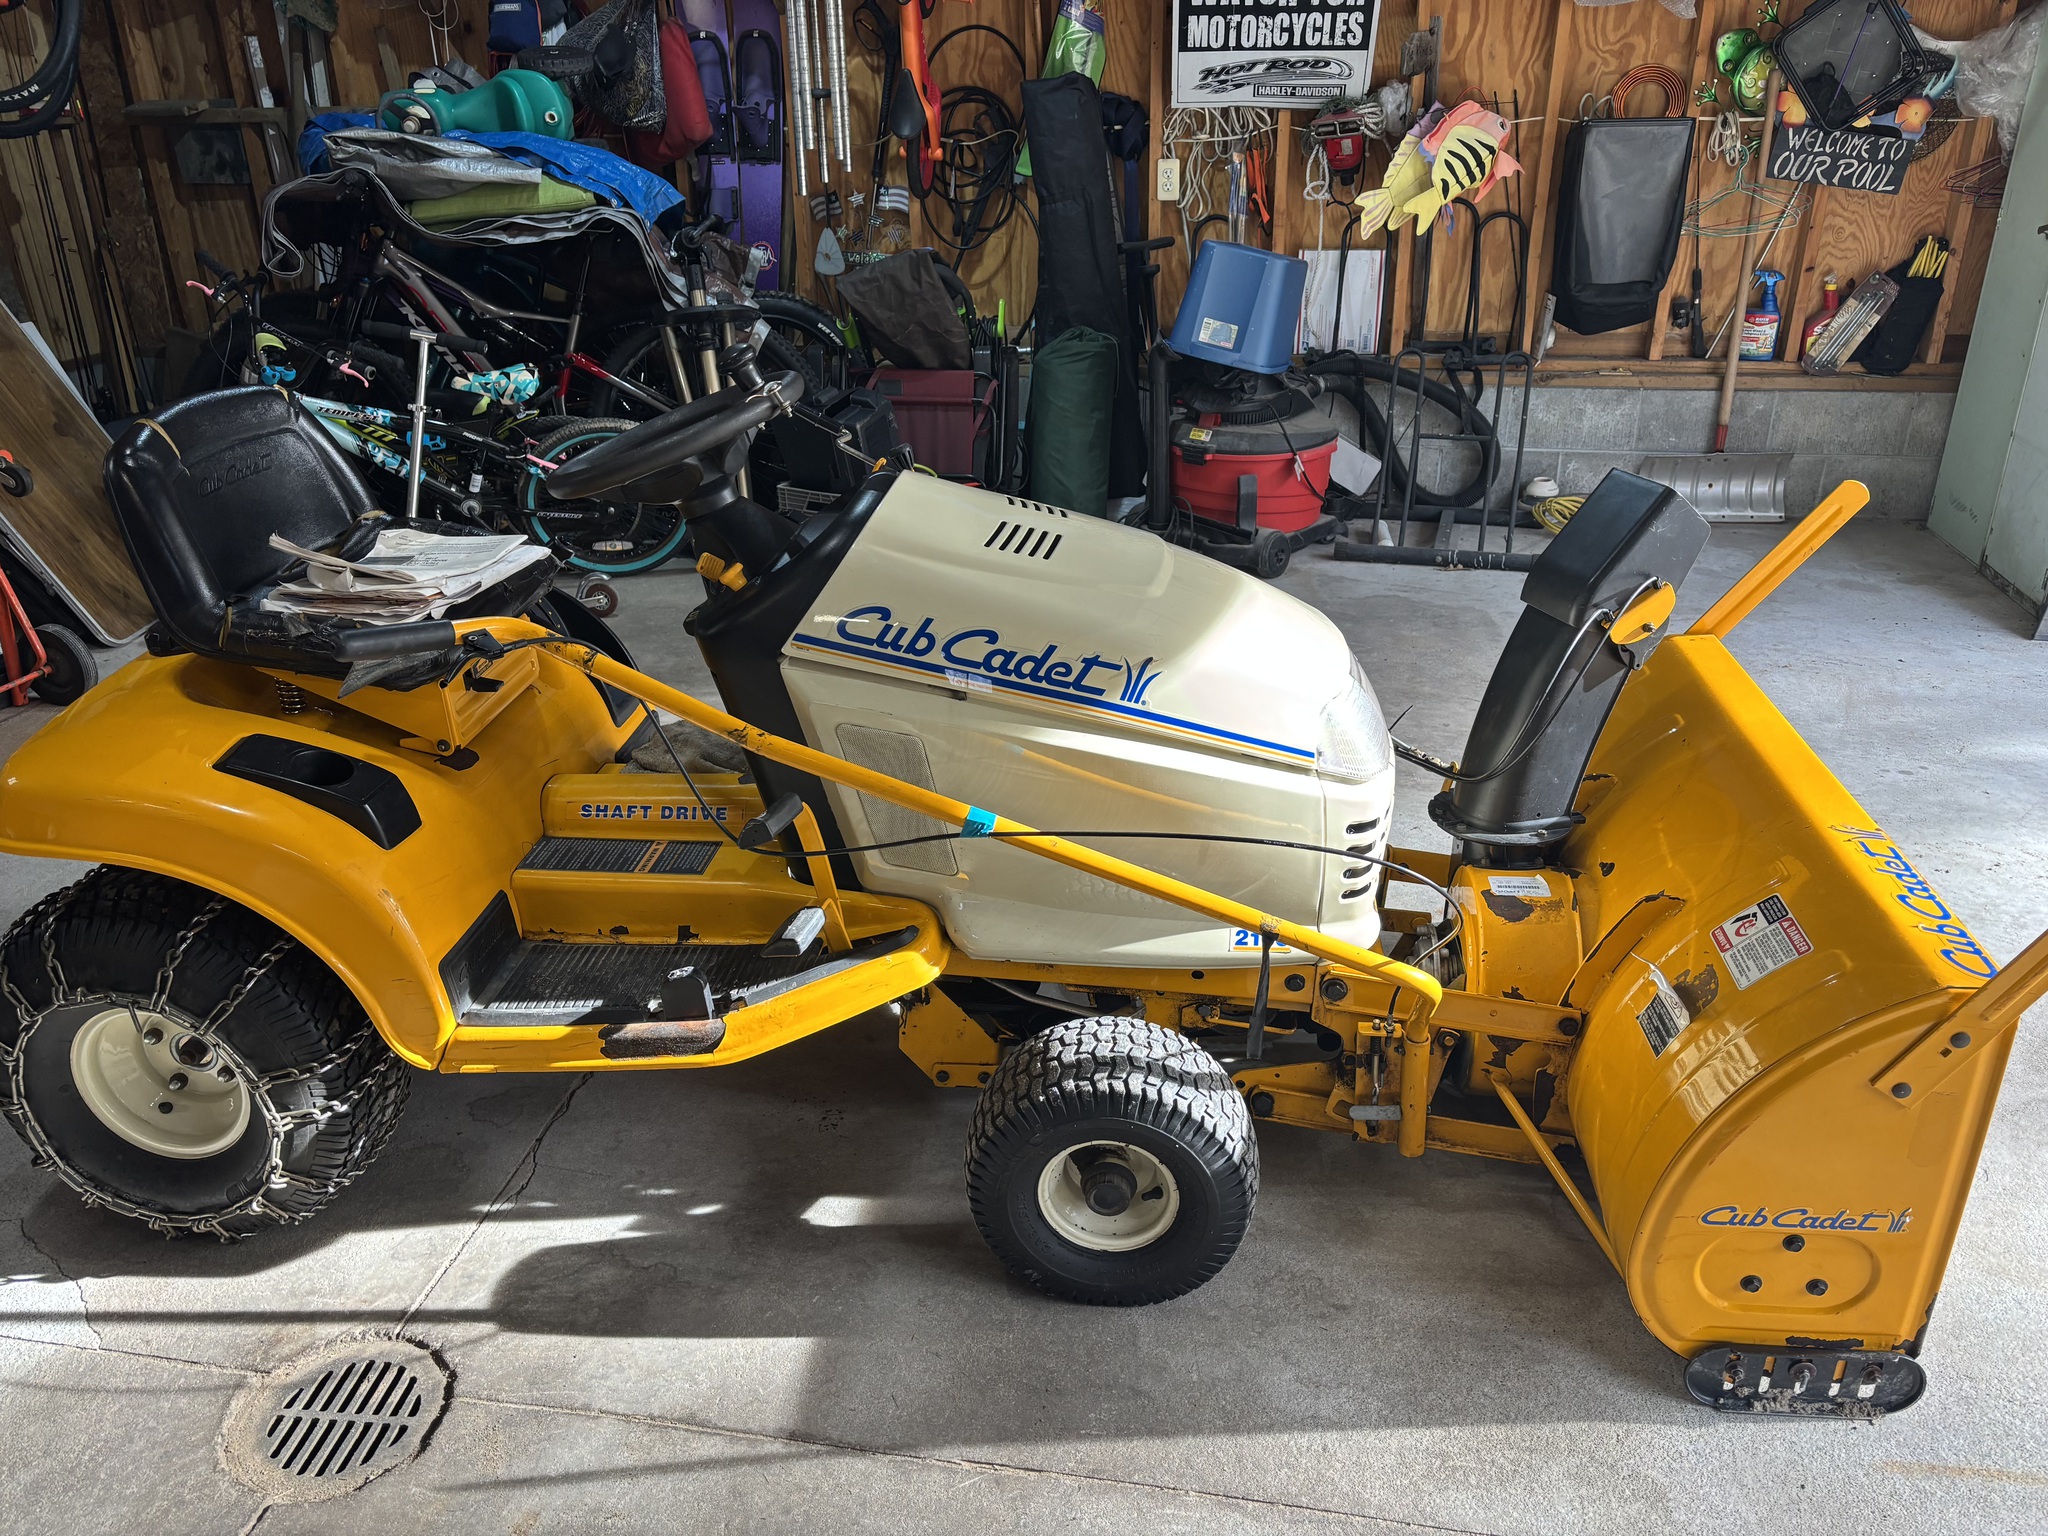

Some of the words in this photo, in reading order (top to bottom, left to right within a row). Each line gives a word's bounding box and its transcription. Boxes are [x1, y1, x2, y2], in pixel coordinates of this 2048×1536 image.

[1187, 12, 1365, 49] MOTORCYCLES
[1198, 61, 1264, 82] HOT
[1264, 57, 1332, 73] ROD
[1258, 86, 1341, 97] HARLEY-DAVIDSON
[1788, 127, 1875, 159] WELCOME
[1878, 137, 1908, 161] TO
[1773, 151, 1828, 186] OUR
[1831, 158, 1895, 191] POOL
[226, 453, 272, 485] Cadet
[836, 606, 936, 656] Cub
[942, 629, 1123, 697] Cadet
[580, 803, 652, 819] SHAFT
[660, 806, 727, 820] DRIVE
[638, 847, 659, 872] WARNING
[1858, 841, 1952, 921] Cadet
[1787, 927, 1808, 953] DANGER
[1918, 923, 1998, 978] Cub
[1701, 1205, 1768, 1227] Cub
[1771, 1208, 1889, 1232] Cadet
